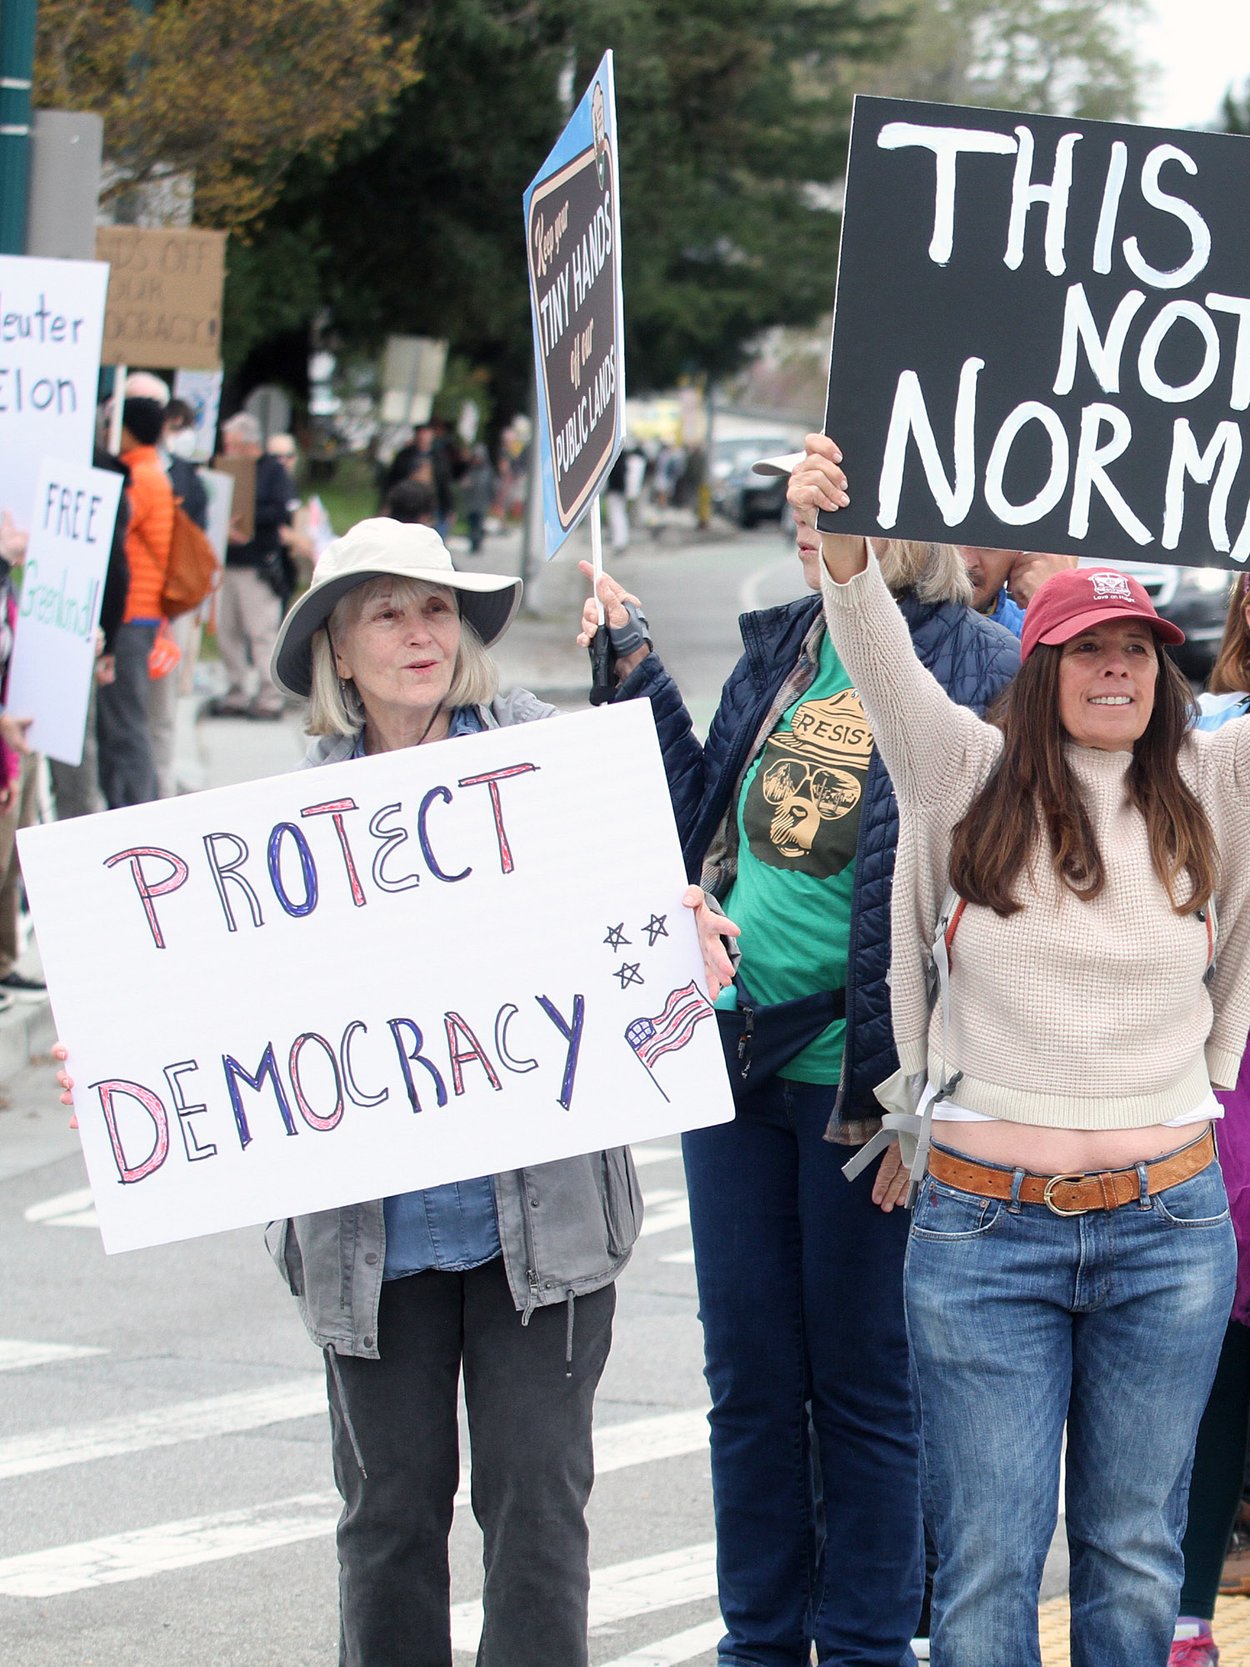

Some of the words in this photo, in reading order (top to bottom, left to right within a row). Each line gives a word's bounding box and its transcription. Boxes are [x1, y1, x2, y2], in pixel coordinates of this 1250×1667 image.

[535, 212, 554, 277] Keep
[555, 200, 569, 254] your
[540, 262, 569, 357] TINY
[572, 190, 612, 312] HANDS
[877, 121, 1211, 289] THIS
[0, 291, 84, 343] euter
[556, 396, 588, 482] PUBLIC
[588, 344, 616, 432] LANDS
[44, 482, 102, 544] FREE
[796, 713, 875, 748] RESIST
[103, 762, 540, 949] PROTECT
[88, 994, 586, 1184] DEMOCRACY
